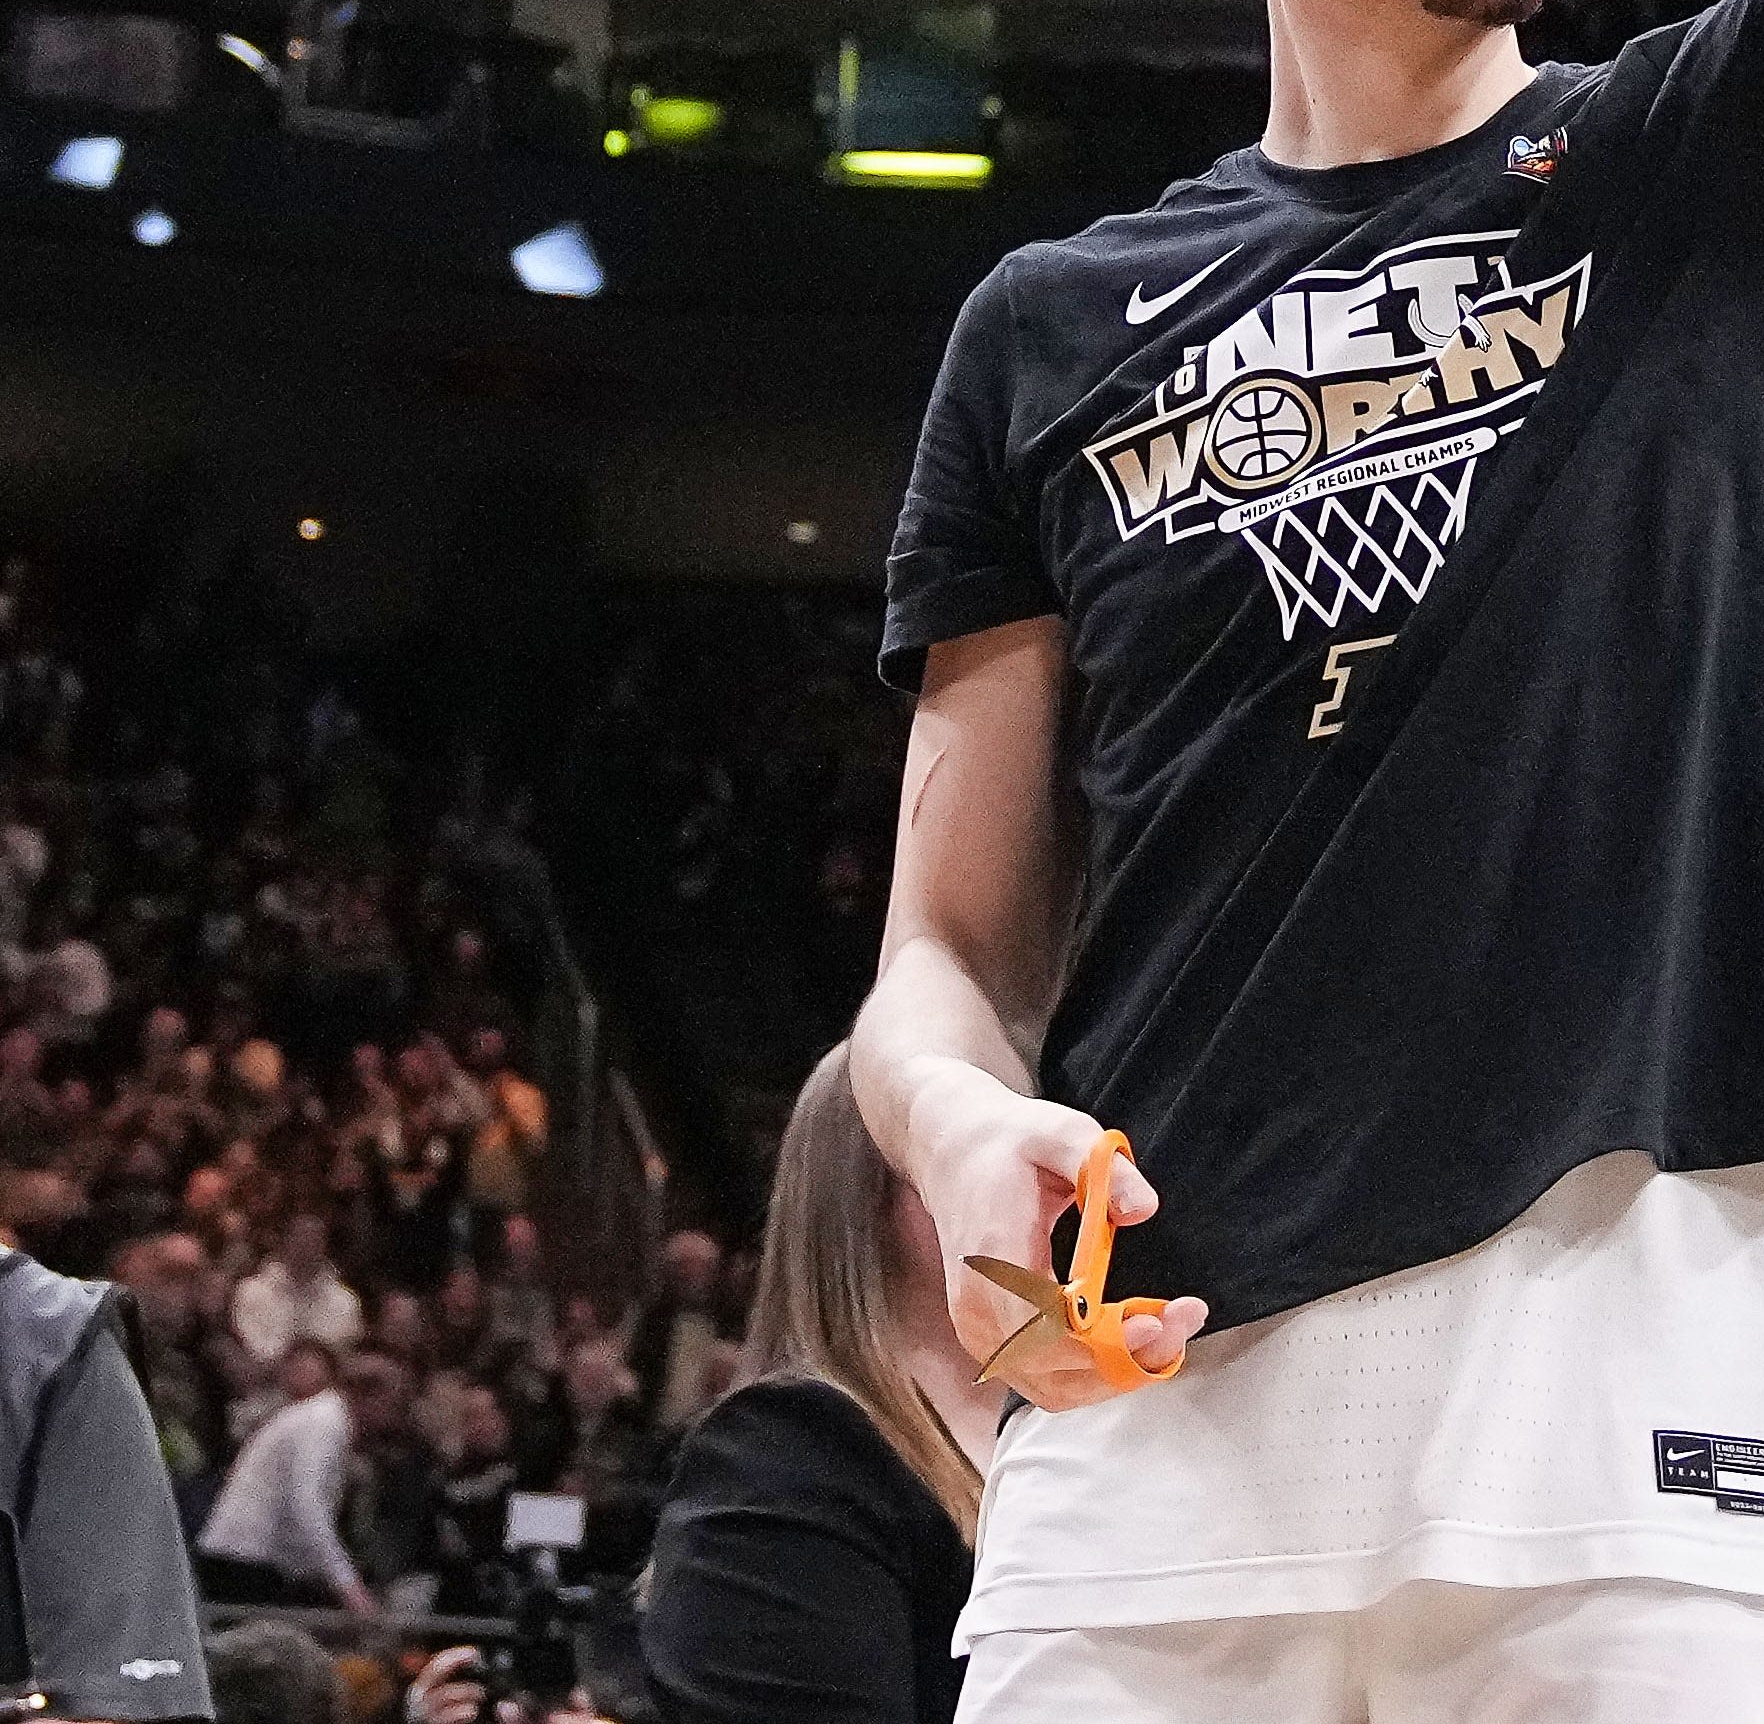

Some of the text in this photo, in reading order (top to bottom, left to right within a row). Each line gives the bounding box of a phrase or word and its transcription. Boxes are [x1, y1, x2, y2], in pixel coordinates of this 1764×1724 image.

[1206, 255, 1479, 396] NET
[1238, 437, 1475, 523] MIDWEST REGIONAL CHAMPS
[1666, 1466, 1709, 1479] TEAM
